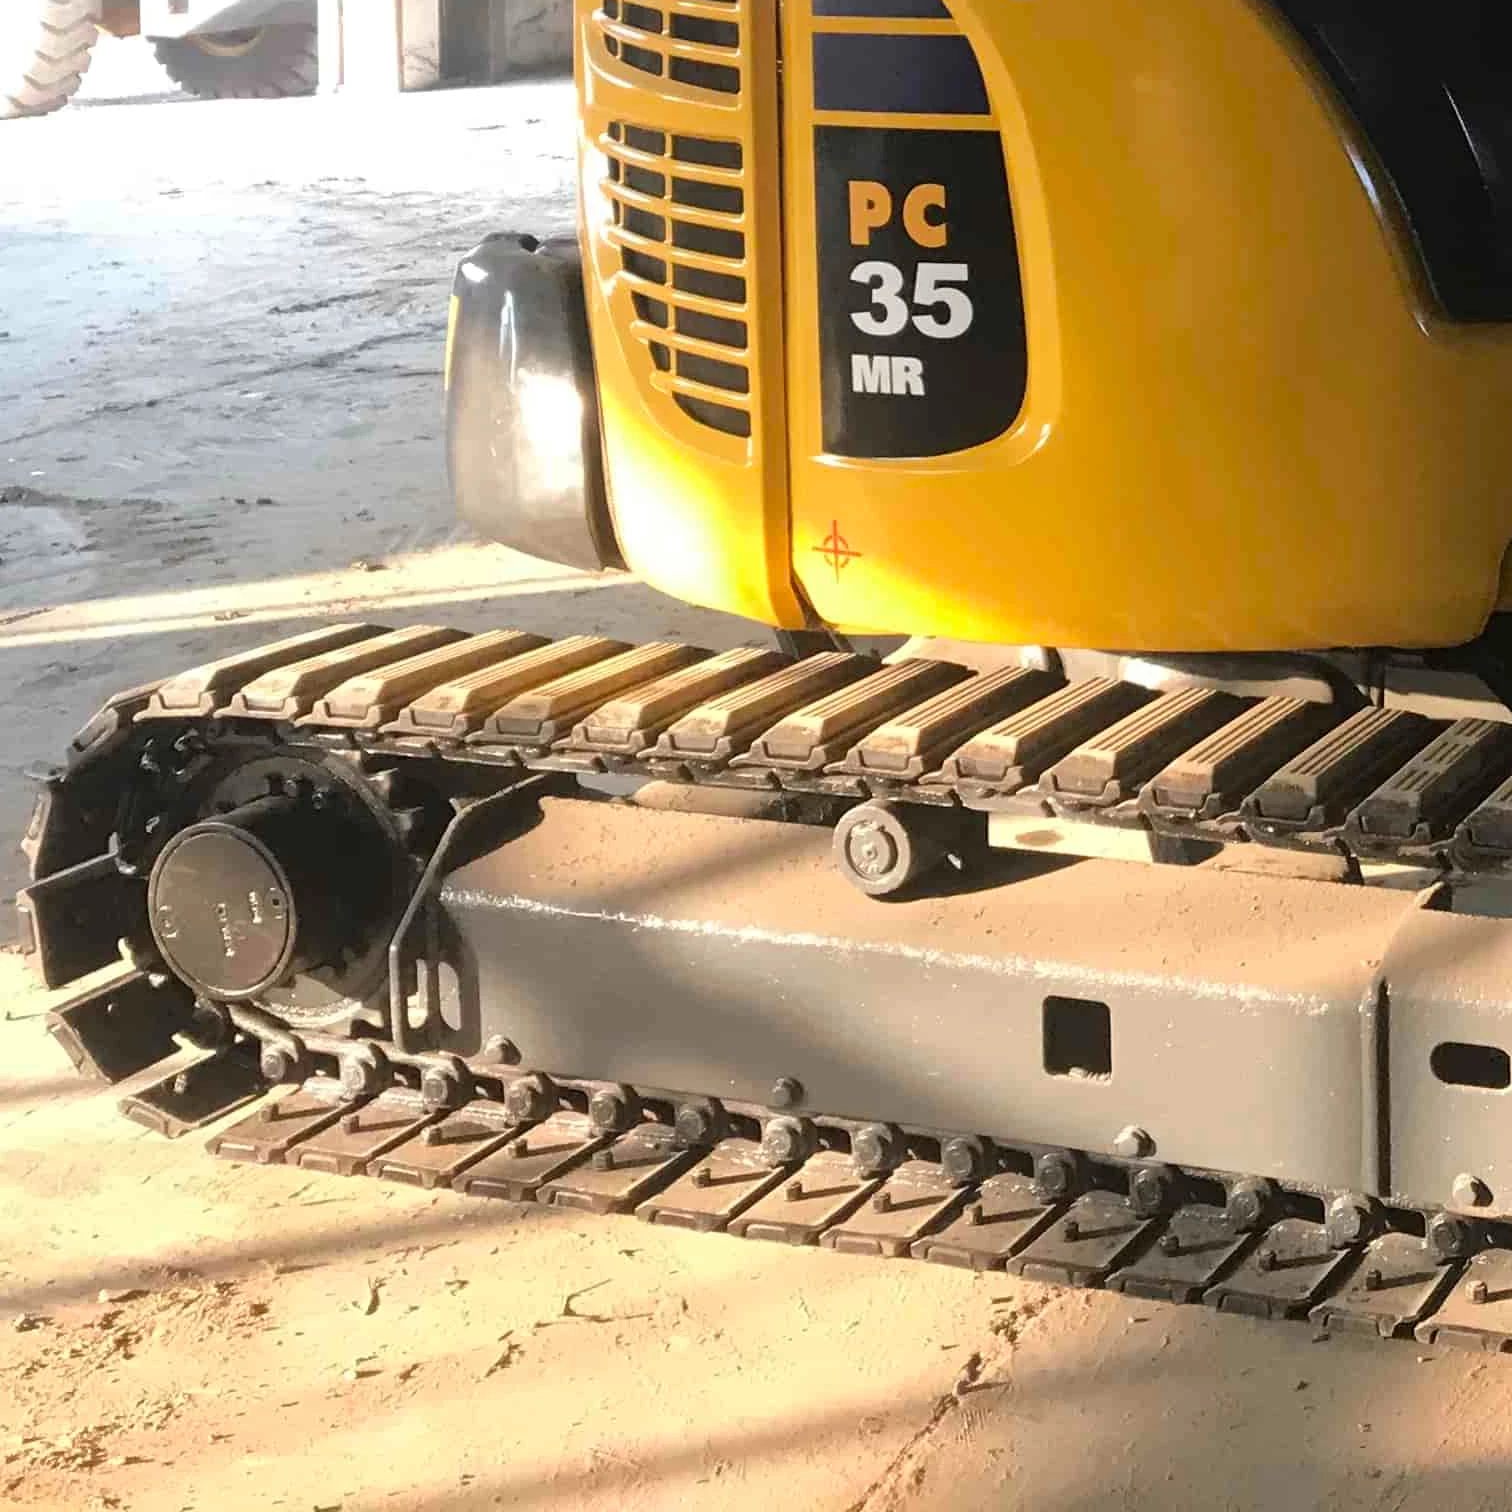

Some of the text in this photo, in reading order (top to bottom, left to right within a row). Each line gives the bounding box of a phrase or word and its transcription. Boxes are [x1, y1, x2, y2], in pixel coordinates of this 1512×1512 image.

[848, 180, 948, 248] PC
[850, 260, 974, 338] 35
[851, 354, 926, 396] MR
